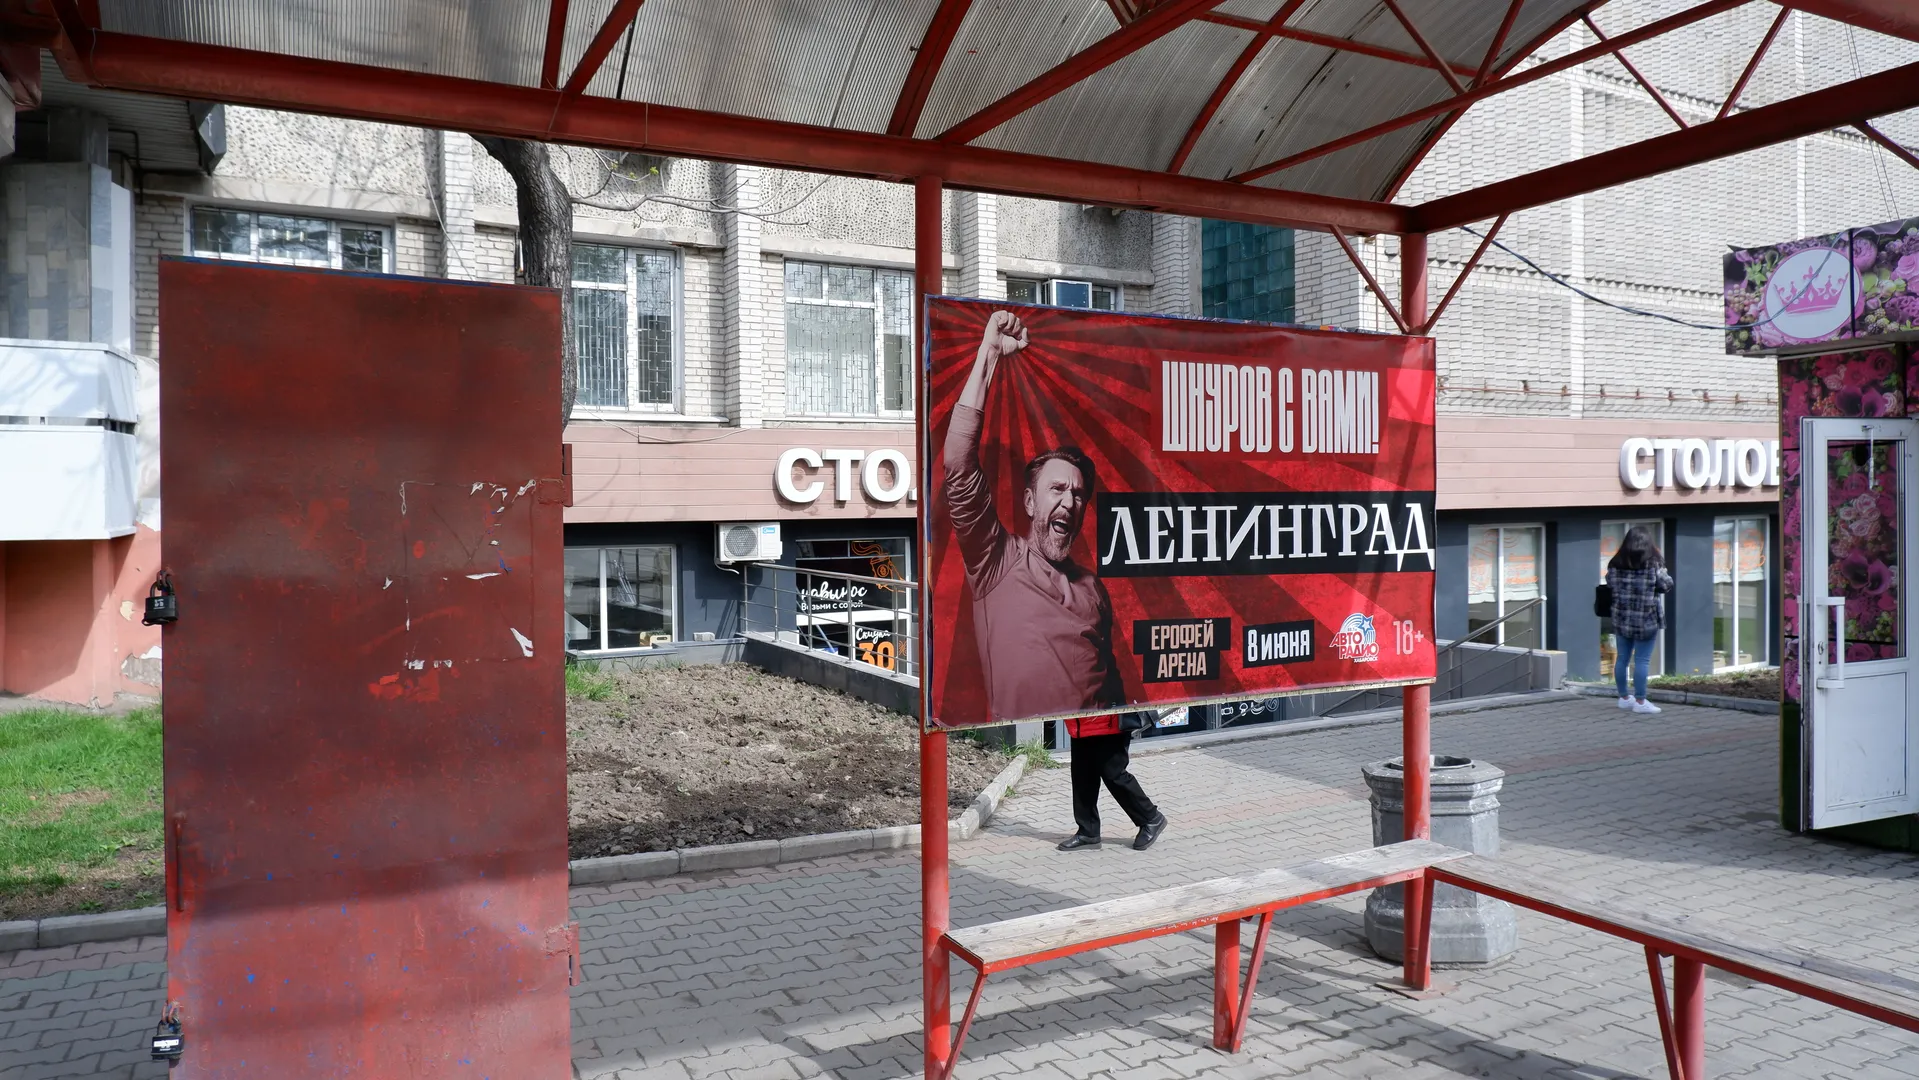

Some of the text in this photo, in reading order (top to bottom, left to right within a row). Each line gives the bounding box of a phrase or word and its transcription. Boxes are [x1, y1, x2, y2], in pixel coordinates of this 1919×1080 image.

[1162, 361, 1379, 454] ШНУРОВ С ВАМИ!
[775, 447, 917, 503] СТО
[1102, 502, 1435, 572] ЛЕНИНГРАД
[839, 599, 863, 609] соой
[1151, 619, 1214, 651] ЕРОФЕЙ
[1247, 629, 1258, 662] 8
[1330, 631, 1363, 647] АВТО
[1339, 643, 1379, 659] РАДИО
[1393, 620, 1424, 655] 18+
[859, 641, 894, 670] 30
[1157, 652, 1207, 679] АРЕНА
